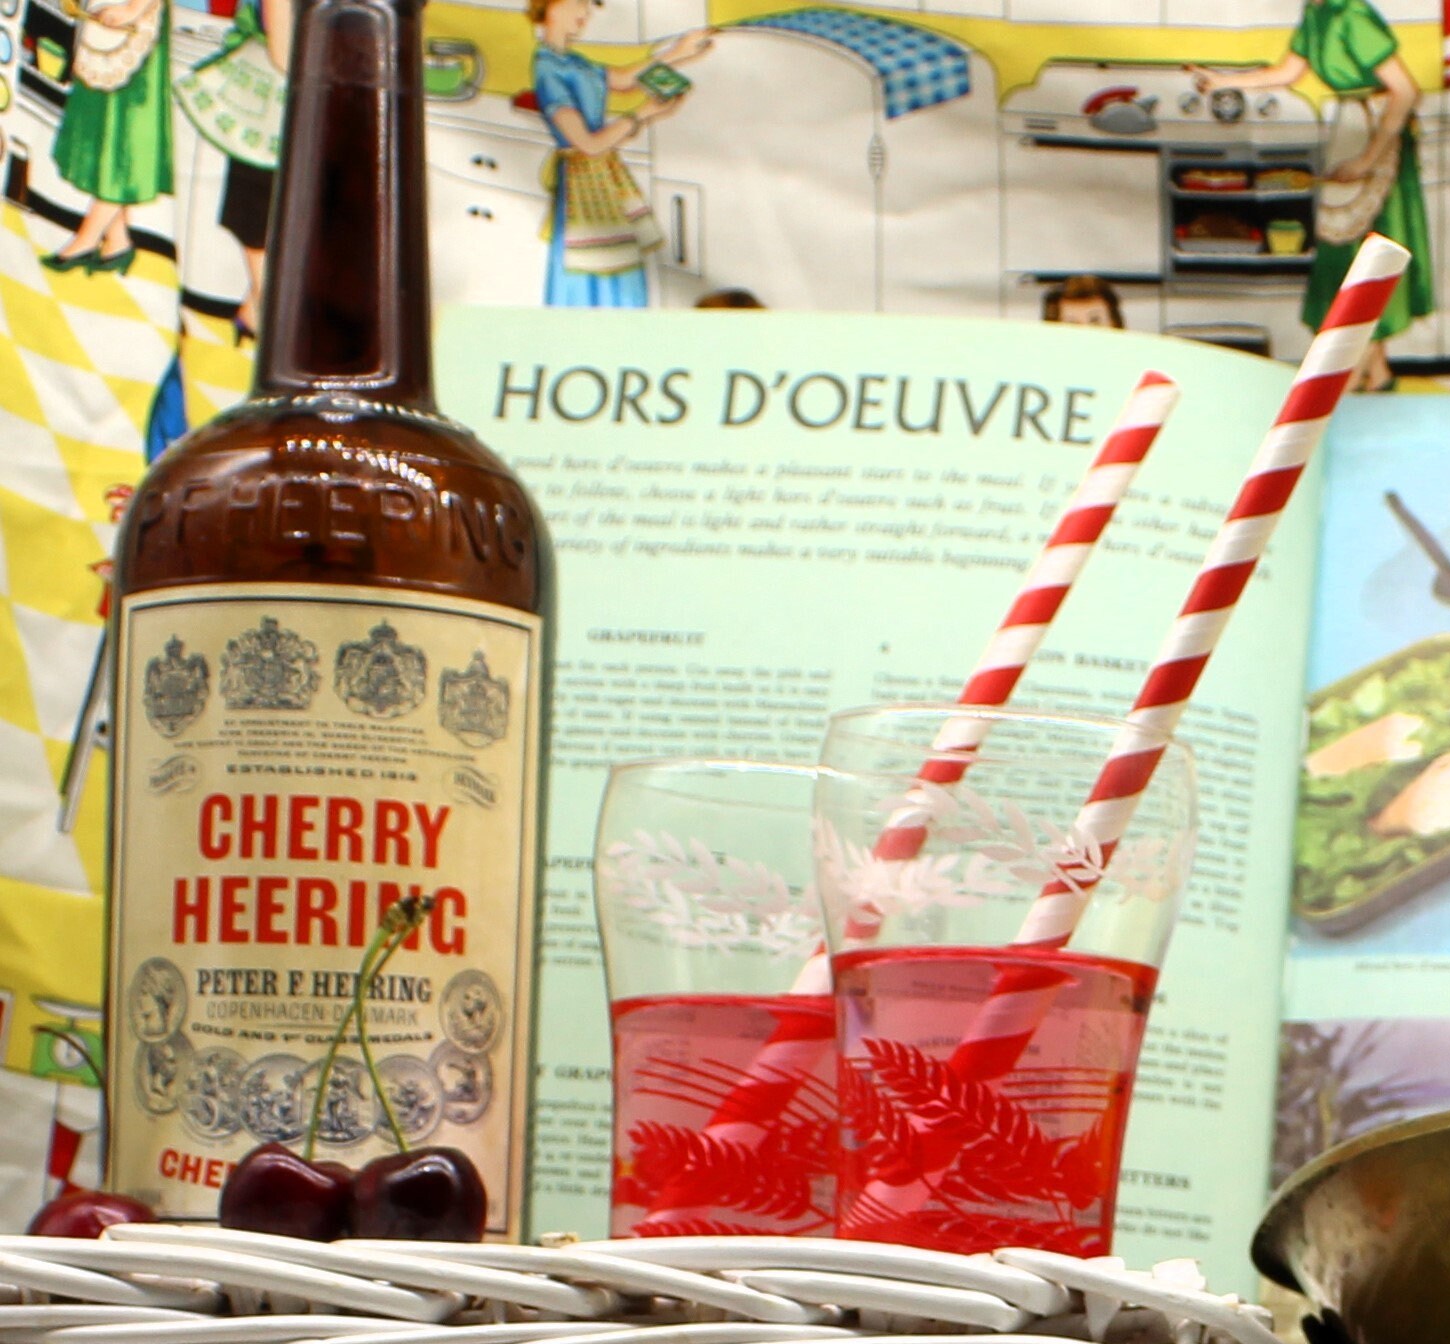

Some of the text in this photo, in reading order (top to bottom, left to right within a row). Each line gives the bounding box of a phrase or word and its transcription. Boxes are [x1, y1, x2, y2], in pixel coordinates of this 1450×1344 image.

[493, 361, 1097, 446] HORS D'OEUVRE
[226, 762, 374, 778] ESTABLISHED
[198, 792, 452, 870] CHERRY
[172, 876, 468, 956] HEERING
[196, 968, 278, 997] PETER
[159, 1147, 240, 1190] CHE
